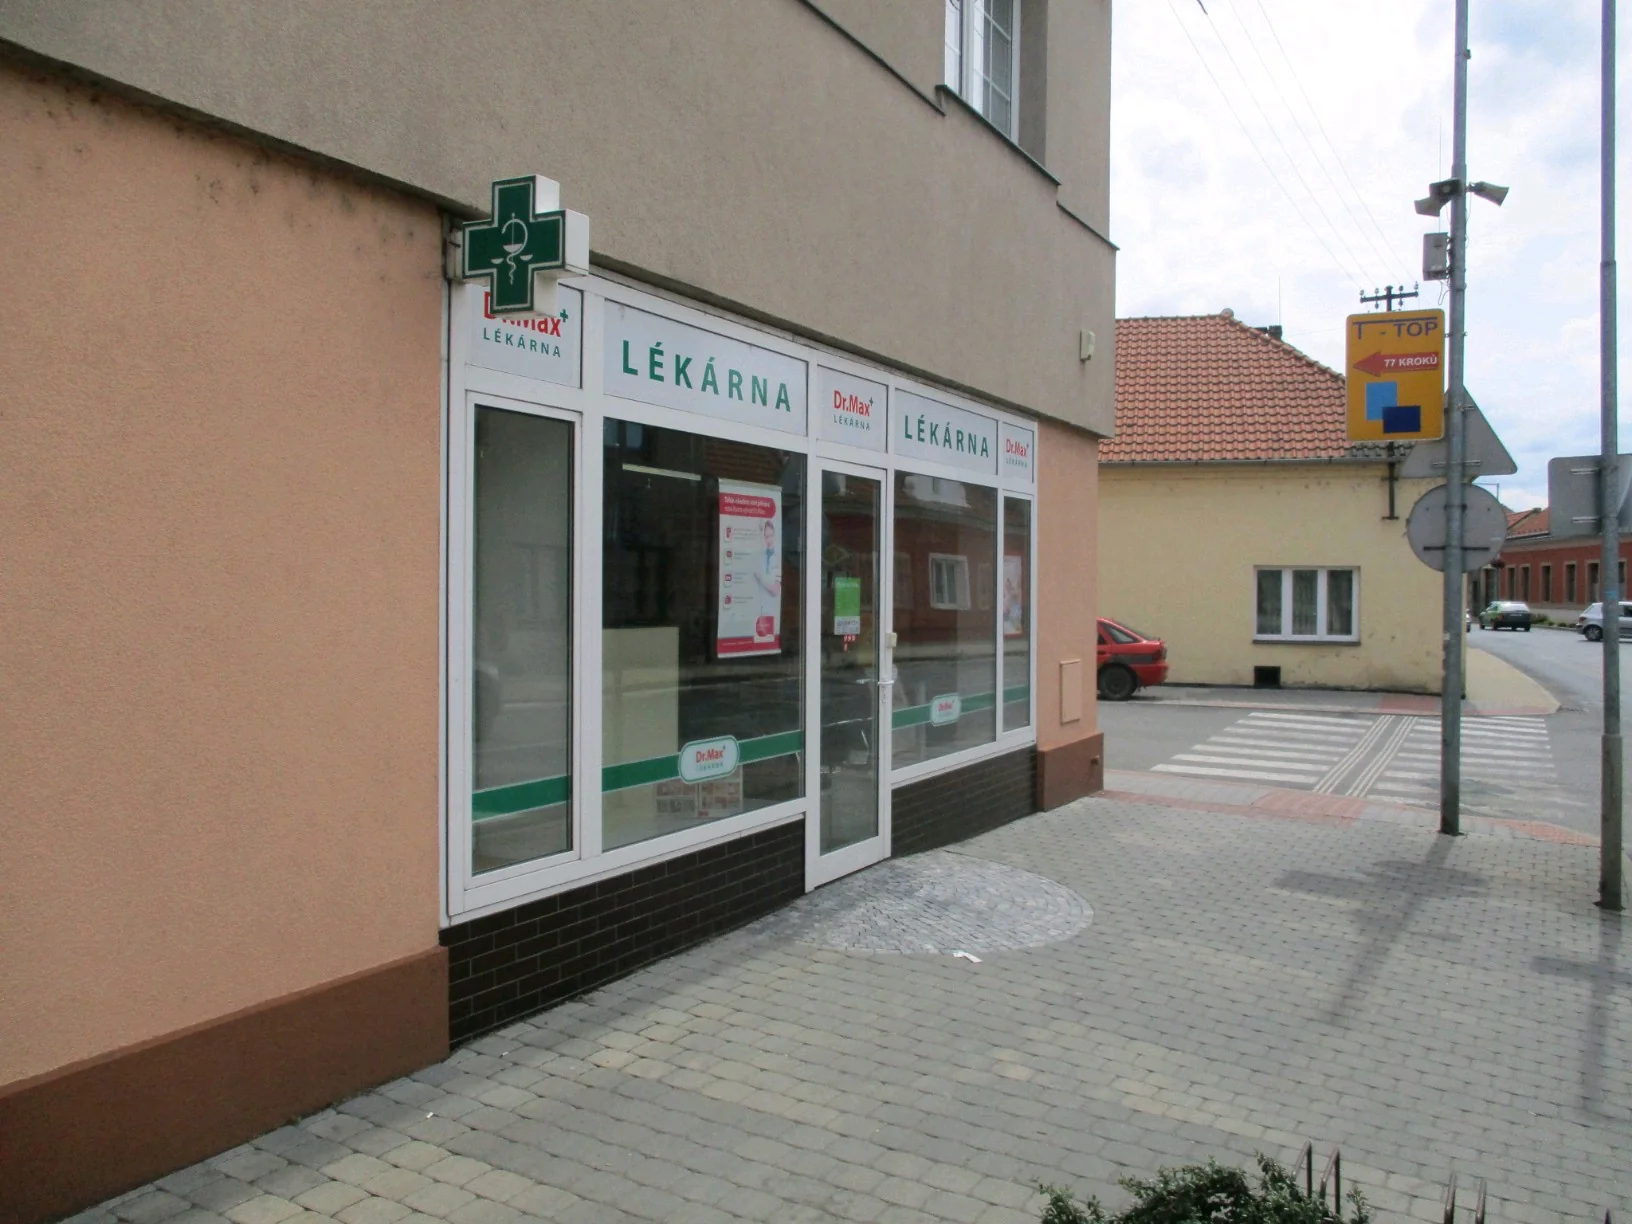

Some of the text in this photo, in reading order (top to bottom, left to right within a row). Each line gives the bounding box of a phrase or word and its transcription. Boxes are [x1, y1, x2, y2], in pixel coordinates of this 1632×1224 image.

[1393, 321, 1438, 338] TOP
[483, 327, 561, 358] LÉKÁRNA
[1384, 354, 1438, 368] 77 KROKŮ
[622, 340, 791, 412] LÉKÁRNA
[833, 390, 870, 417] Dr.Max
[833, 414, 871, 431] LÉKÁRNA
[904, 415, 989, 458] LÉKÁRNA
[695, 748, 724, 764] Dr.Max
